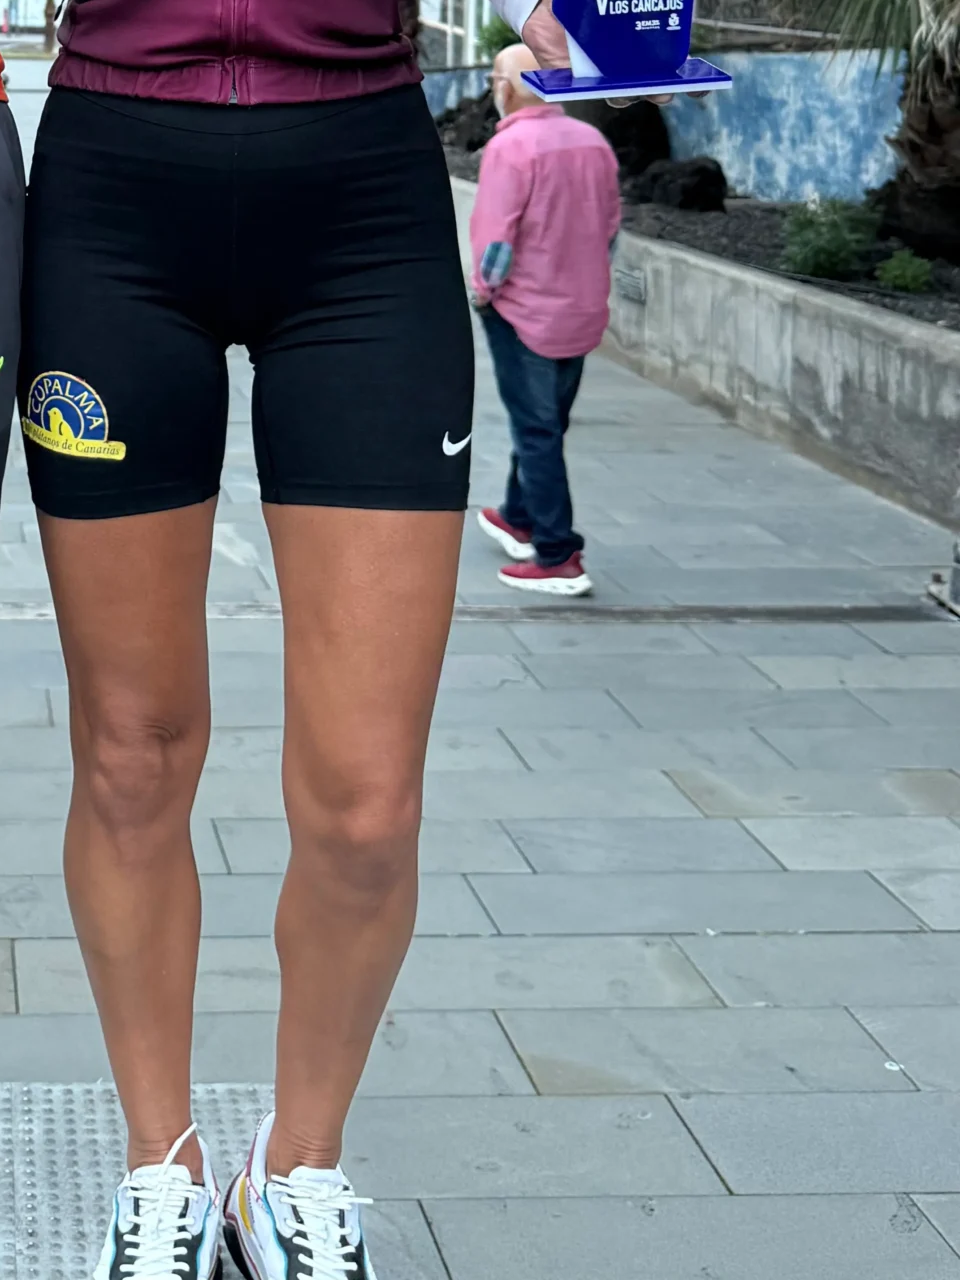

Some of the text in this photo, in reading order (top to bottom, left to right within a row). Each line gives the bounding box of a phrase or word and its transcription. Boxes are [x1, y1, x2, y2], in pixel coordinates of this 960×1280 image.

[609, 0, 629, 15] LOS
[61, 439, 73, 451] de
[75, 441, 121, 456] Canarias
